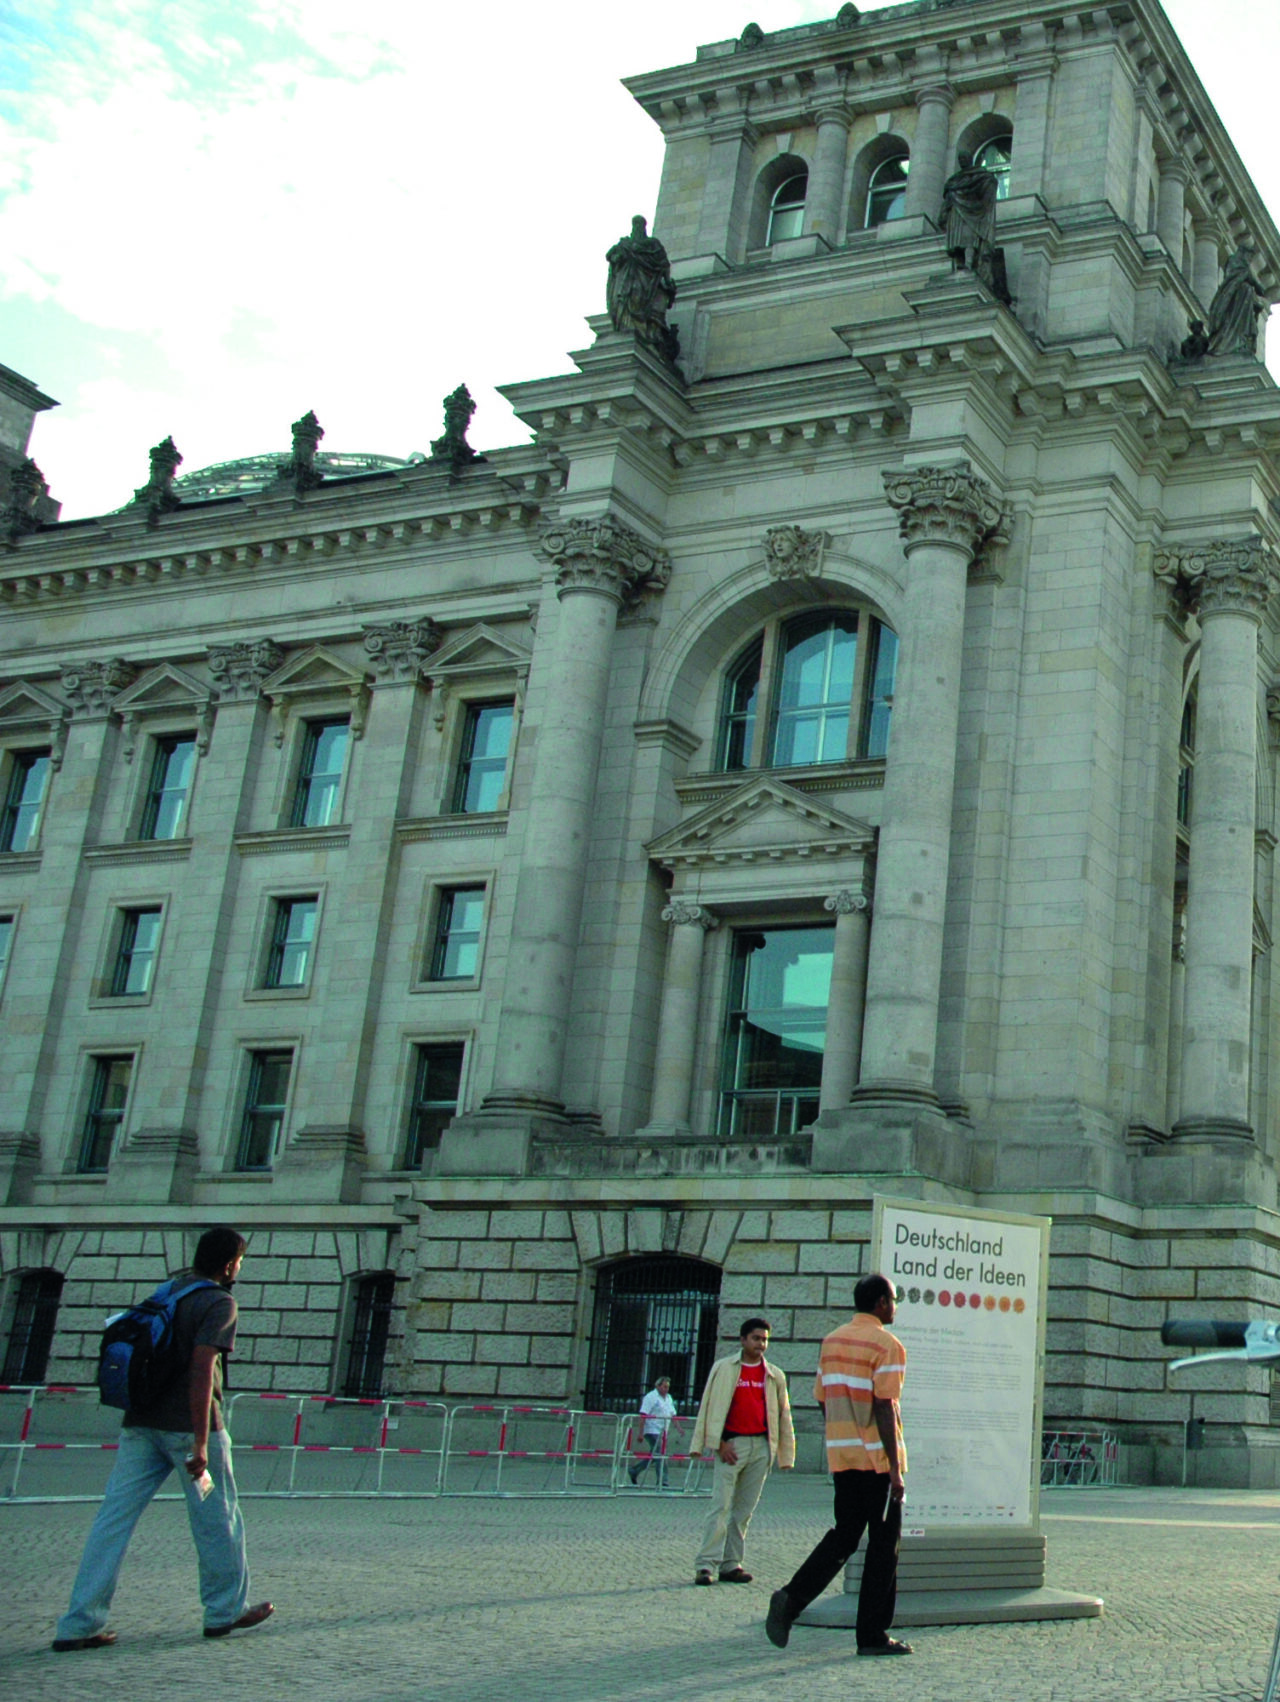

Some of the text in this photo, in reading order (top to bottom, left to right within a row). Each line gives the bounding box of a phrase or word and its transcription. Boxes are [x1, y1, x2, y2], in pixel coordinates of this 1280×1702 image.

[896, 1223, 1003, 1256] Deutschland
[894, 1252, 1026, 1287] Land der Ideen
